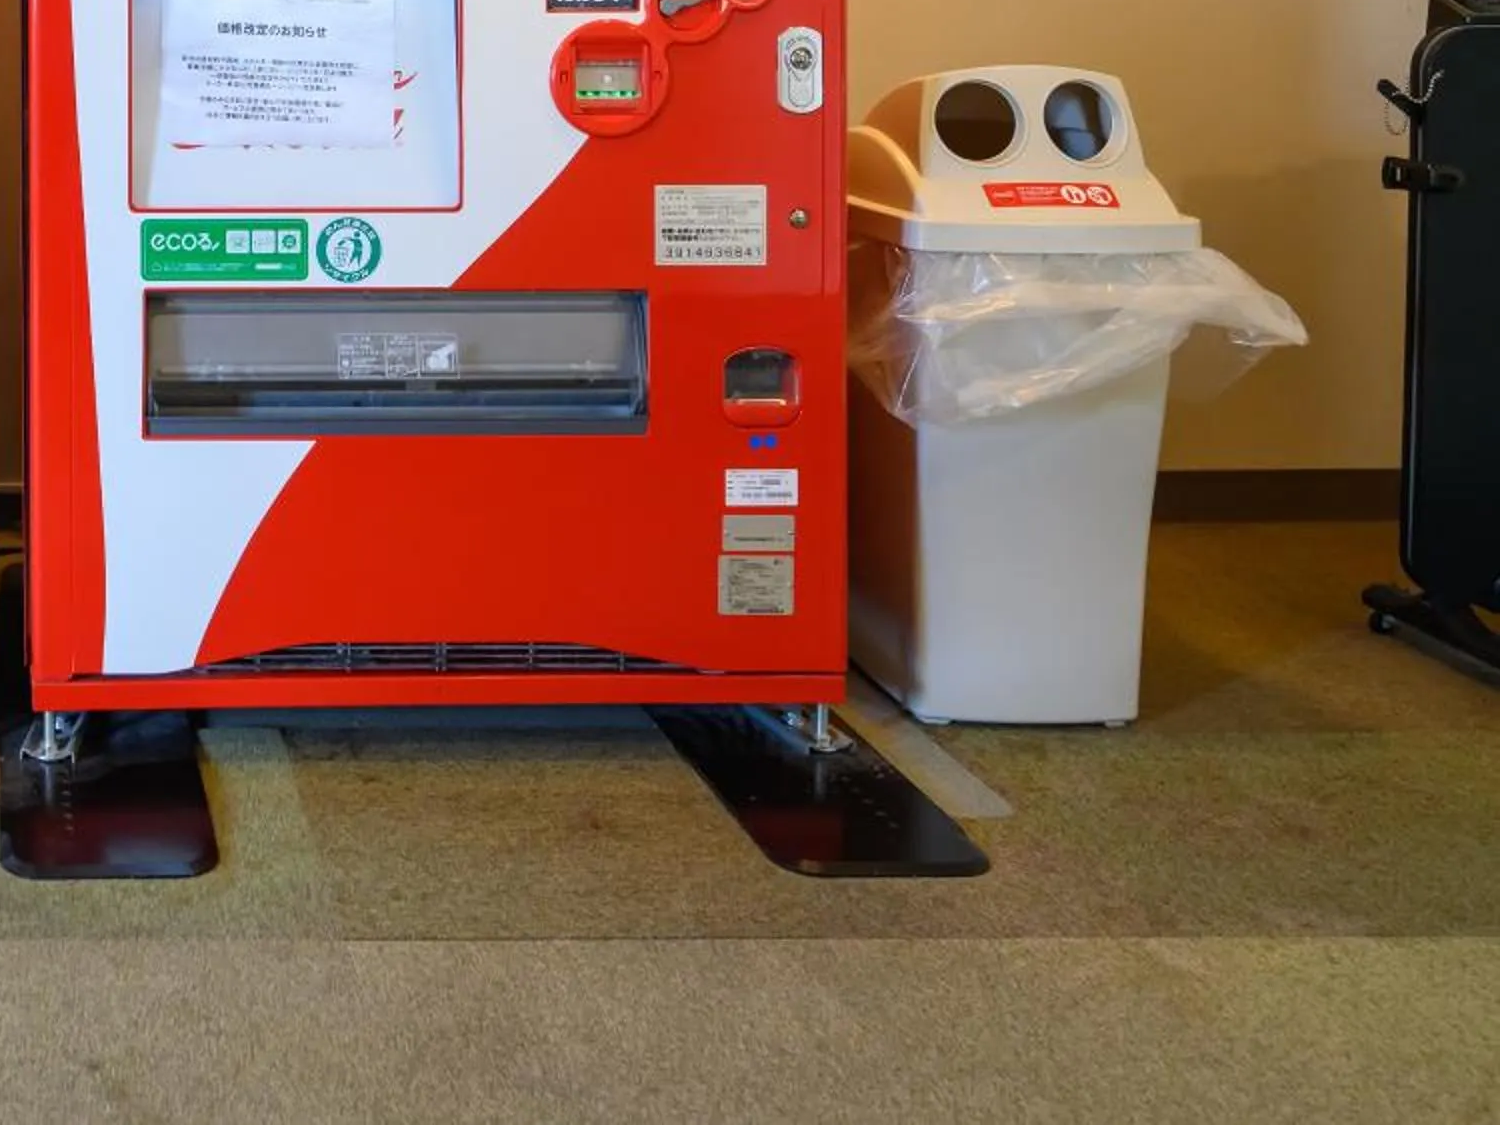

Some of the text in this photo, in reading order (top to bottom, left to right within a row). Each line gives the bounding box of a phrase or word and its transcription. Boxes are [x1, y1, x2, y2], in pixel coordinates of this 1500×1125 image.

[217, 21, 328, 38] 価格改定のお知らせ
